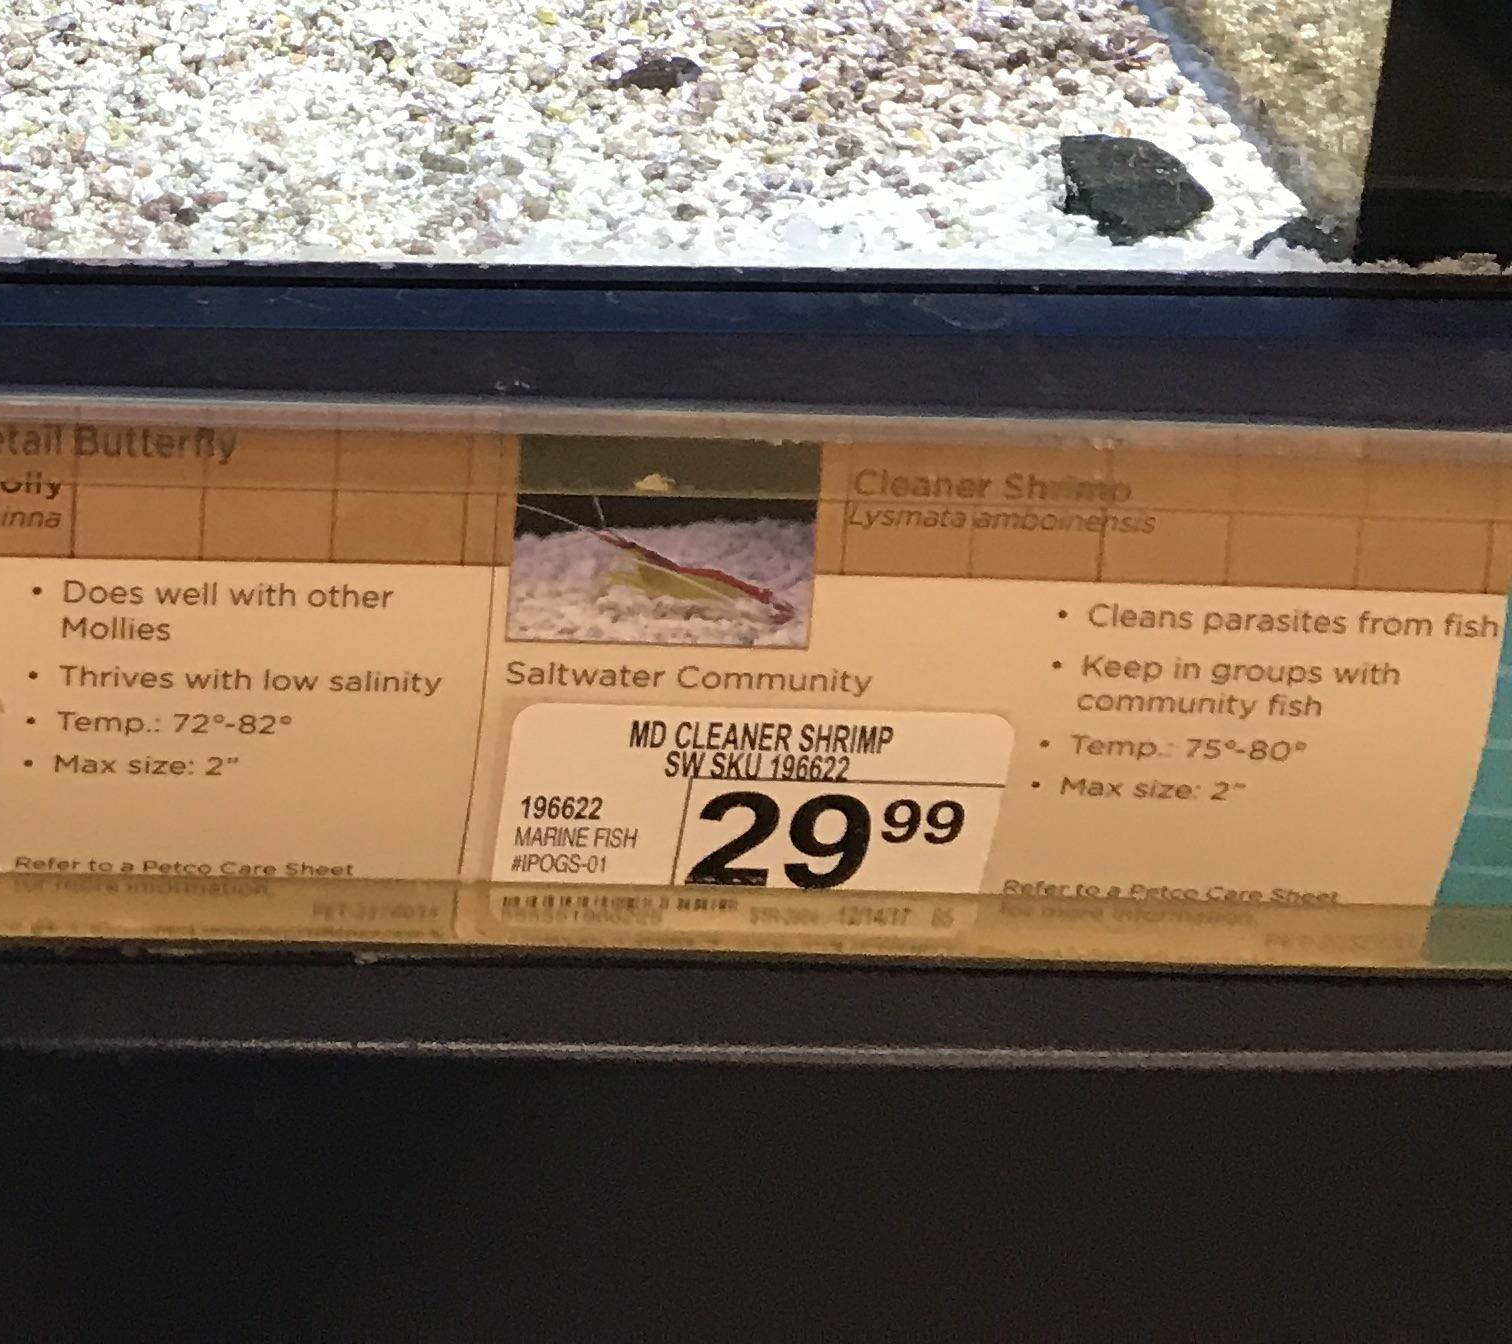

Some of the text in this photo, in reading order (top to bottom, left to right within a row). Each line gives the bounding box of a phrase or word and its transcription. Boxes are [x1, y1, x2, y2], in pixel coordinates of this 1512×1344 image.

[74, 426, 236, 465] Butterfly
[853, 468, 992, 499] Cleaner
[63, 581, 393, 610] Does well with other
[62, 617, 171, 641] Mollies
[1088, 604, 1499, 638] Cleans parasites from fish
[59, 666, 442, 697] Thrives with low salinity
[506, 661, 872, 696] Saltwater Community
[1081, 655, 1400, 689] Keep in groups with
[1077, 692, 1322, 720] community fish
[629, 721, 894, 754] MD CLEANER SHRIMP
[54, 754, 117, 775] Max
[128, 756, 194, 777] size:
[664, 751, 850, 783] SW SKU 196622
[1059, 777, 1123, 799] Max
[1134, 779, 1202, 801] size:
[519, 796, 604, 820] 196622
[881, 799, 965, 844] 99
[514, 826, 638, 849] MARINE FISH
[685, 791, 871, 890] 29
[15, 856, 354, 877] Refer to a Petco Care Sheet
[511, 853, 607, 874] #IPOGS-01
